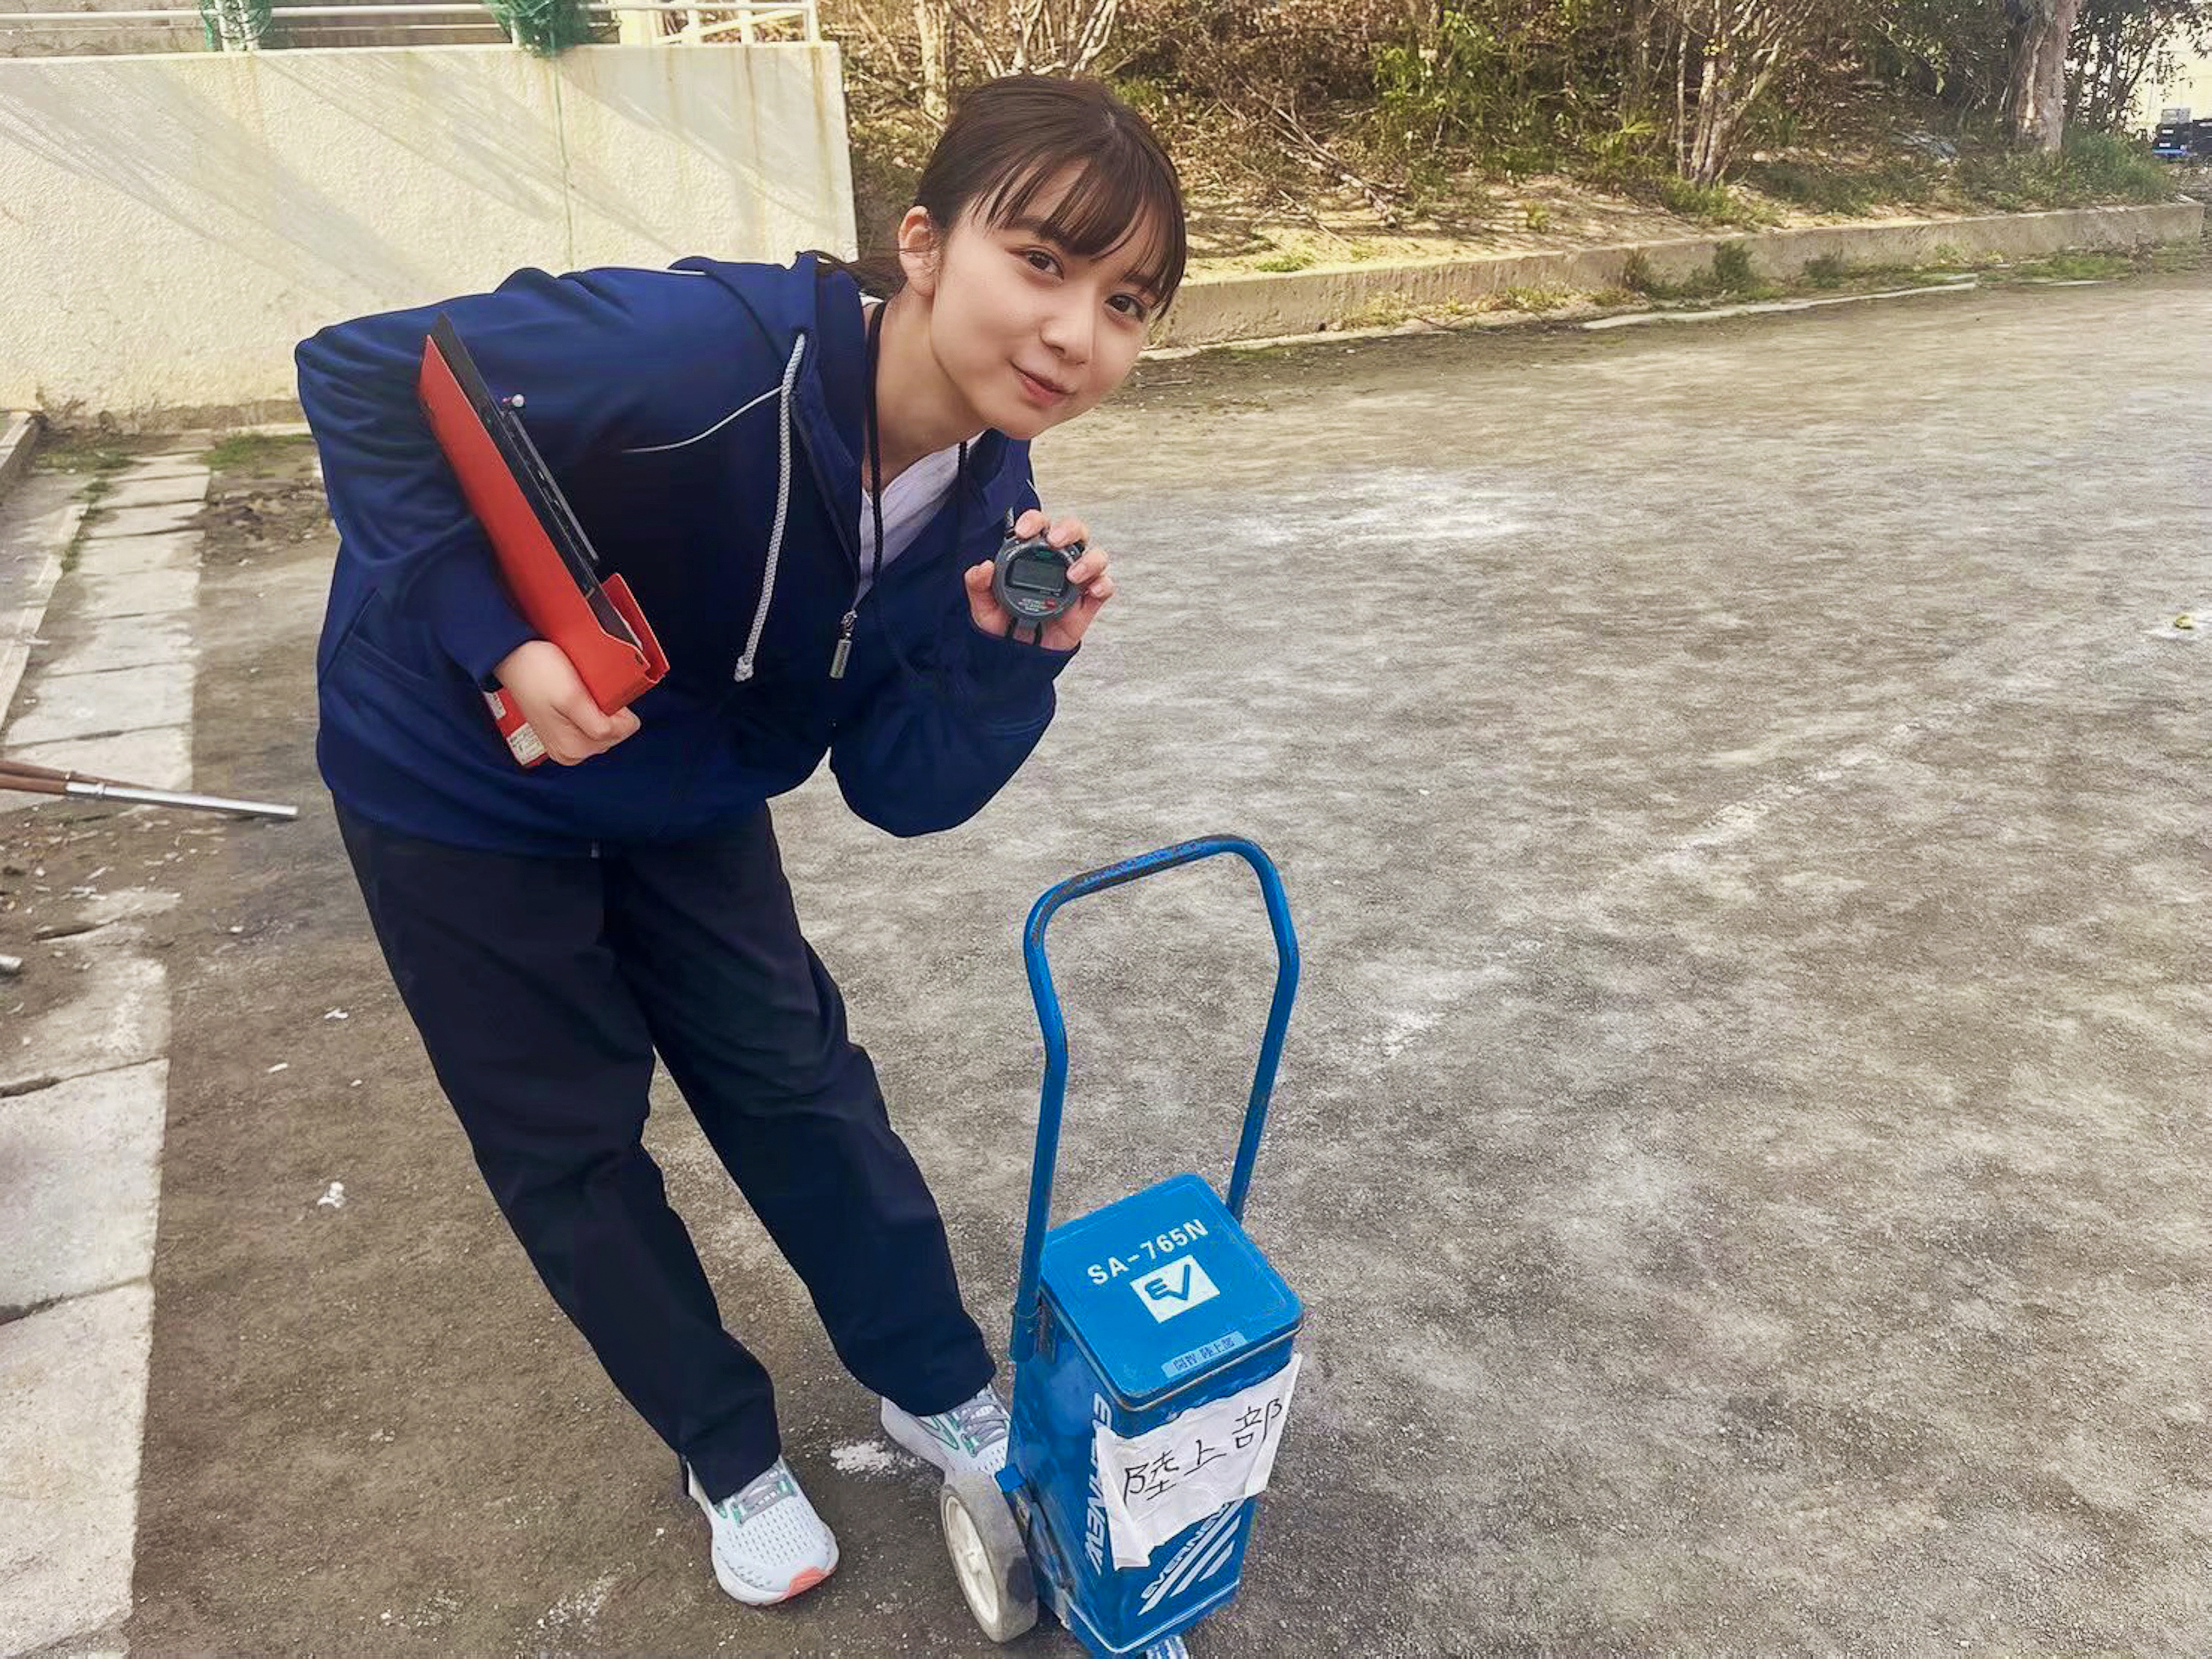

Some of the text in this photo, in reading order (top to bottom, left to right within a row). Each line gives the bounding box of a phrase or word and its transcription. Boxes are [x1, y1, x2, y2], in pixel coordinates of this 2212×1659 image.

[1087, 1218, 1209, 1285] SA-765N
[1124, 1397, 1283, 1506] 陸上部
